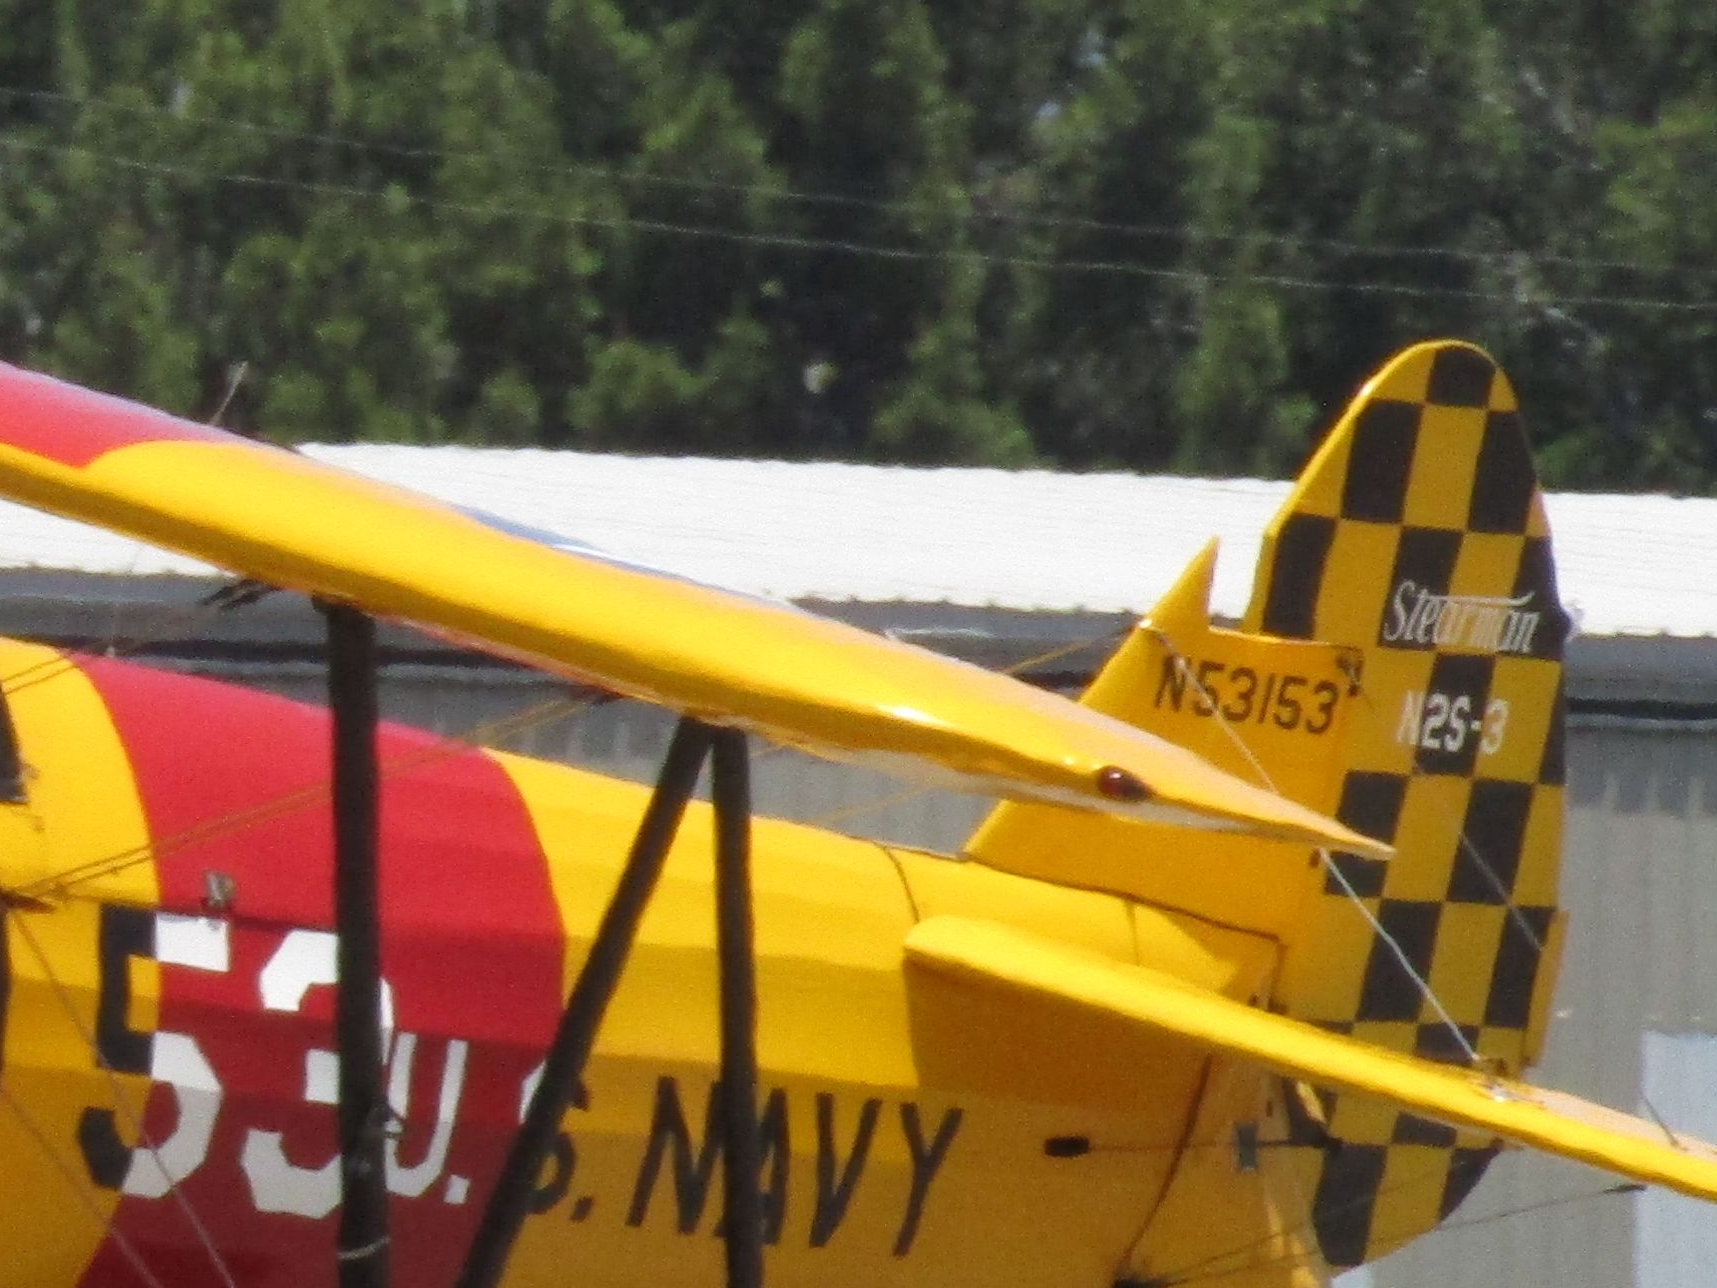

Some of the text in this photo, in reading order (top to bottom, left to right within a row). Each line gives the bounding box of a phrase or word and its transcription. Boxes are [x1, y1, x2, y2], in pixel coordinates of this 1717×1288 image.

[1383, 579, 1541, 654] Stearman
[1153, 652, 1341, 736] N53153
[1394, 689, 1511, 757] N2S-3
[623, 1075, 964, 1258] NAVY
